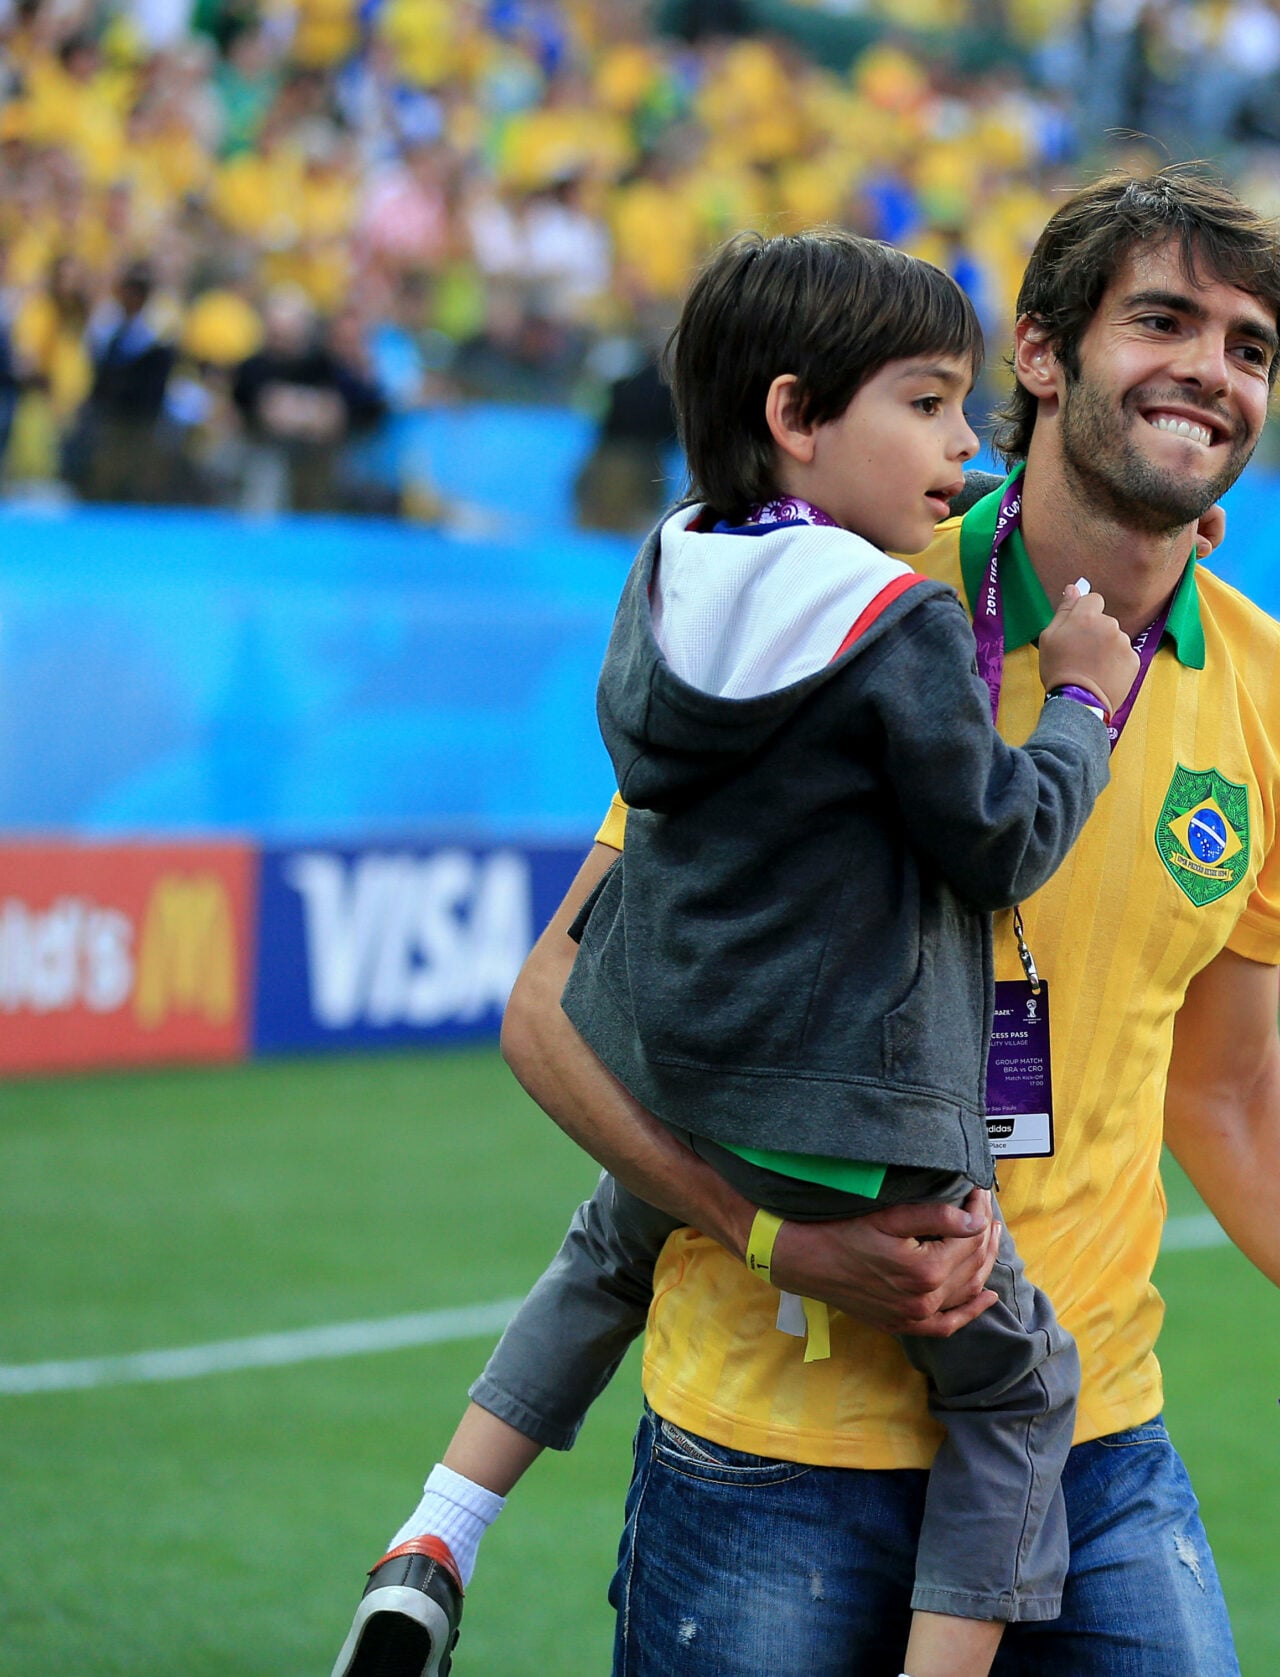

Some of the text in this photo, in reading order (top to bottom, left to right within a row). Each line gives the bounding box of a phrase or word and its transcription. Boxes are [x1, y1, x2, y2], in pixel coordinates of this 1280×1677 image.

[985, 587, 997, 616] 2014
[288, 847, 534, 1029] VISA
[995, 1058, 1019, 1066] GROUP
[987, 1124, 1012, 1133] didas
